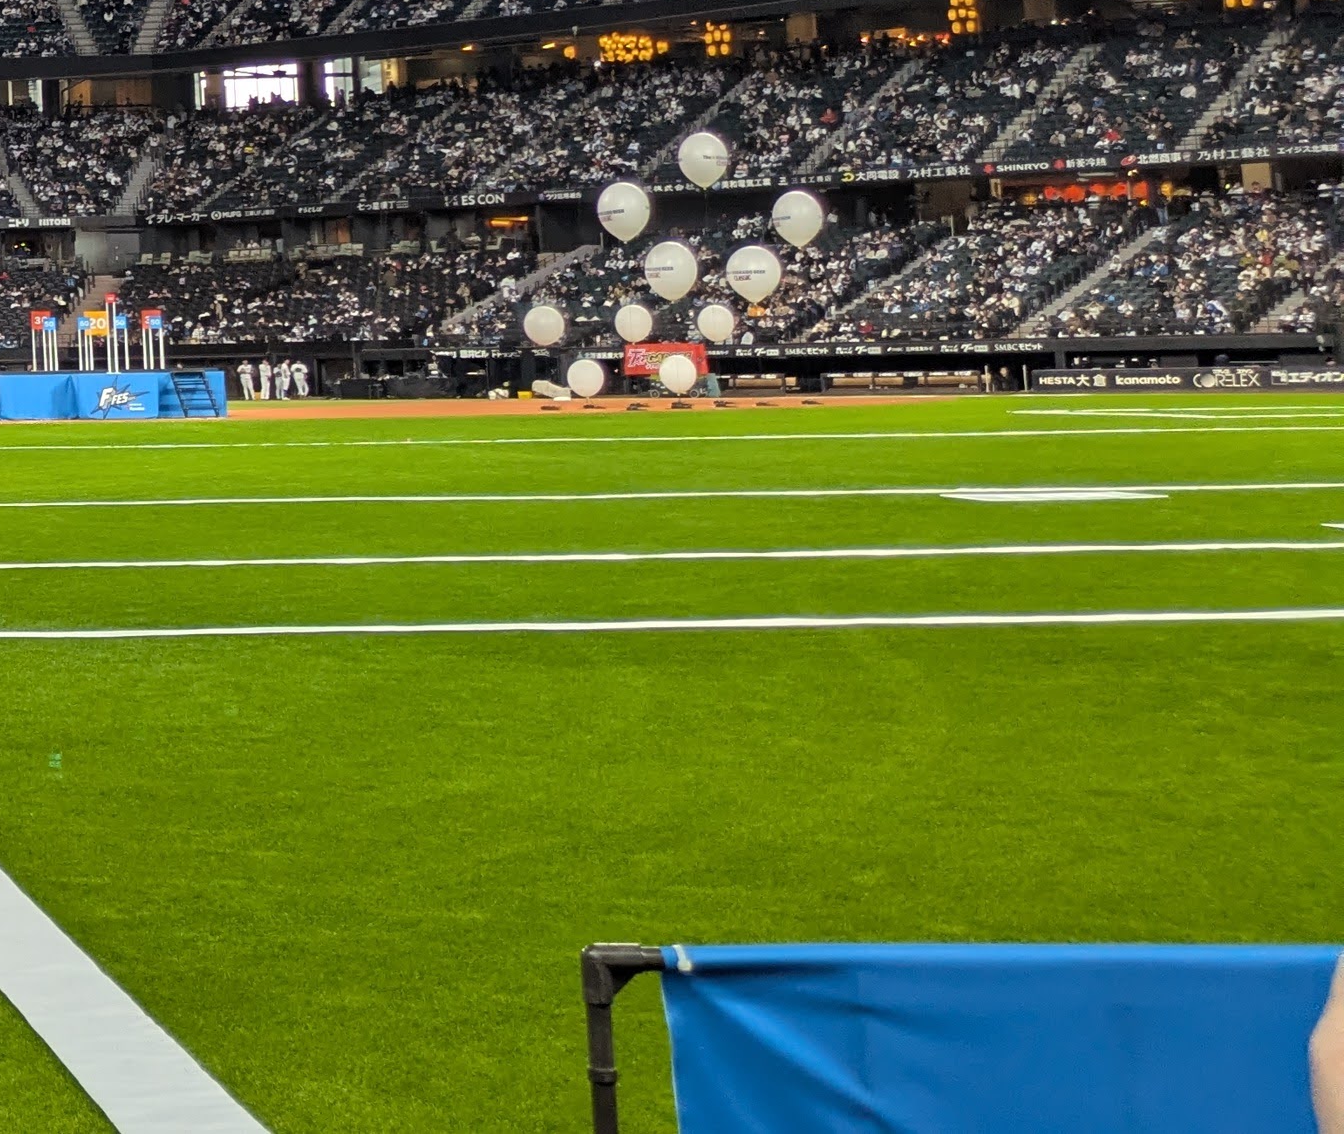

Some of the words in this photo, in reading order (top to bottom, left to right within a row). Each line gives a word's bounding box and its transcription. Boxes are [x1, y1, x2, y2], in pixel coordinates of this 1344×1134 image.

[1197, 146, 1271, 161] 乃村工藝社
[907, 165, 972, 179] 乃村工藝社
[996, 162, 1049, 173] SHINRYO
[462, 195, 476, 206] ES
[477, 192, 506, 206] CON
[8, 218, 30, 228] ニトリ
[38, 218, 71, 227] NITORI
[90, 317, 107, 330] 20
[1115, 374, 1182, 385] kanamoto
[1288, 371, 1344, 383] エディオン
[111, 392, 129, 406] FES
